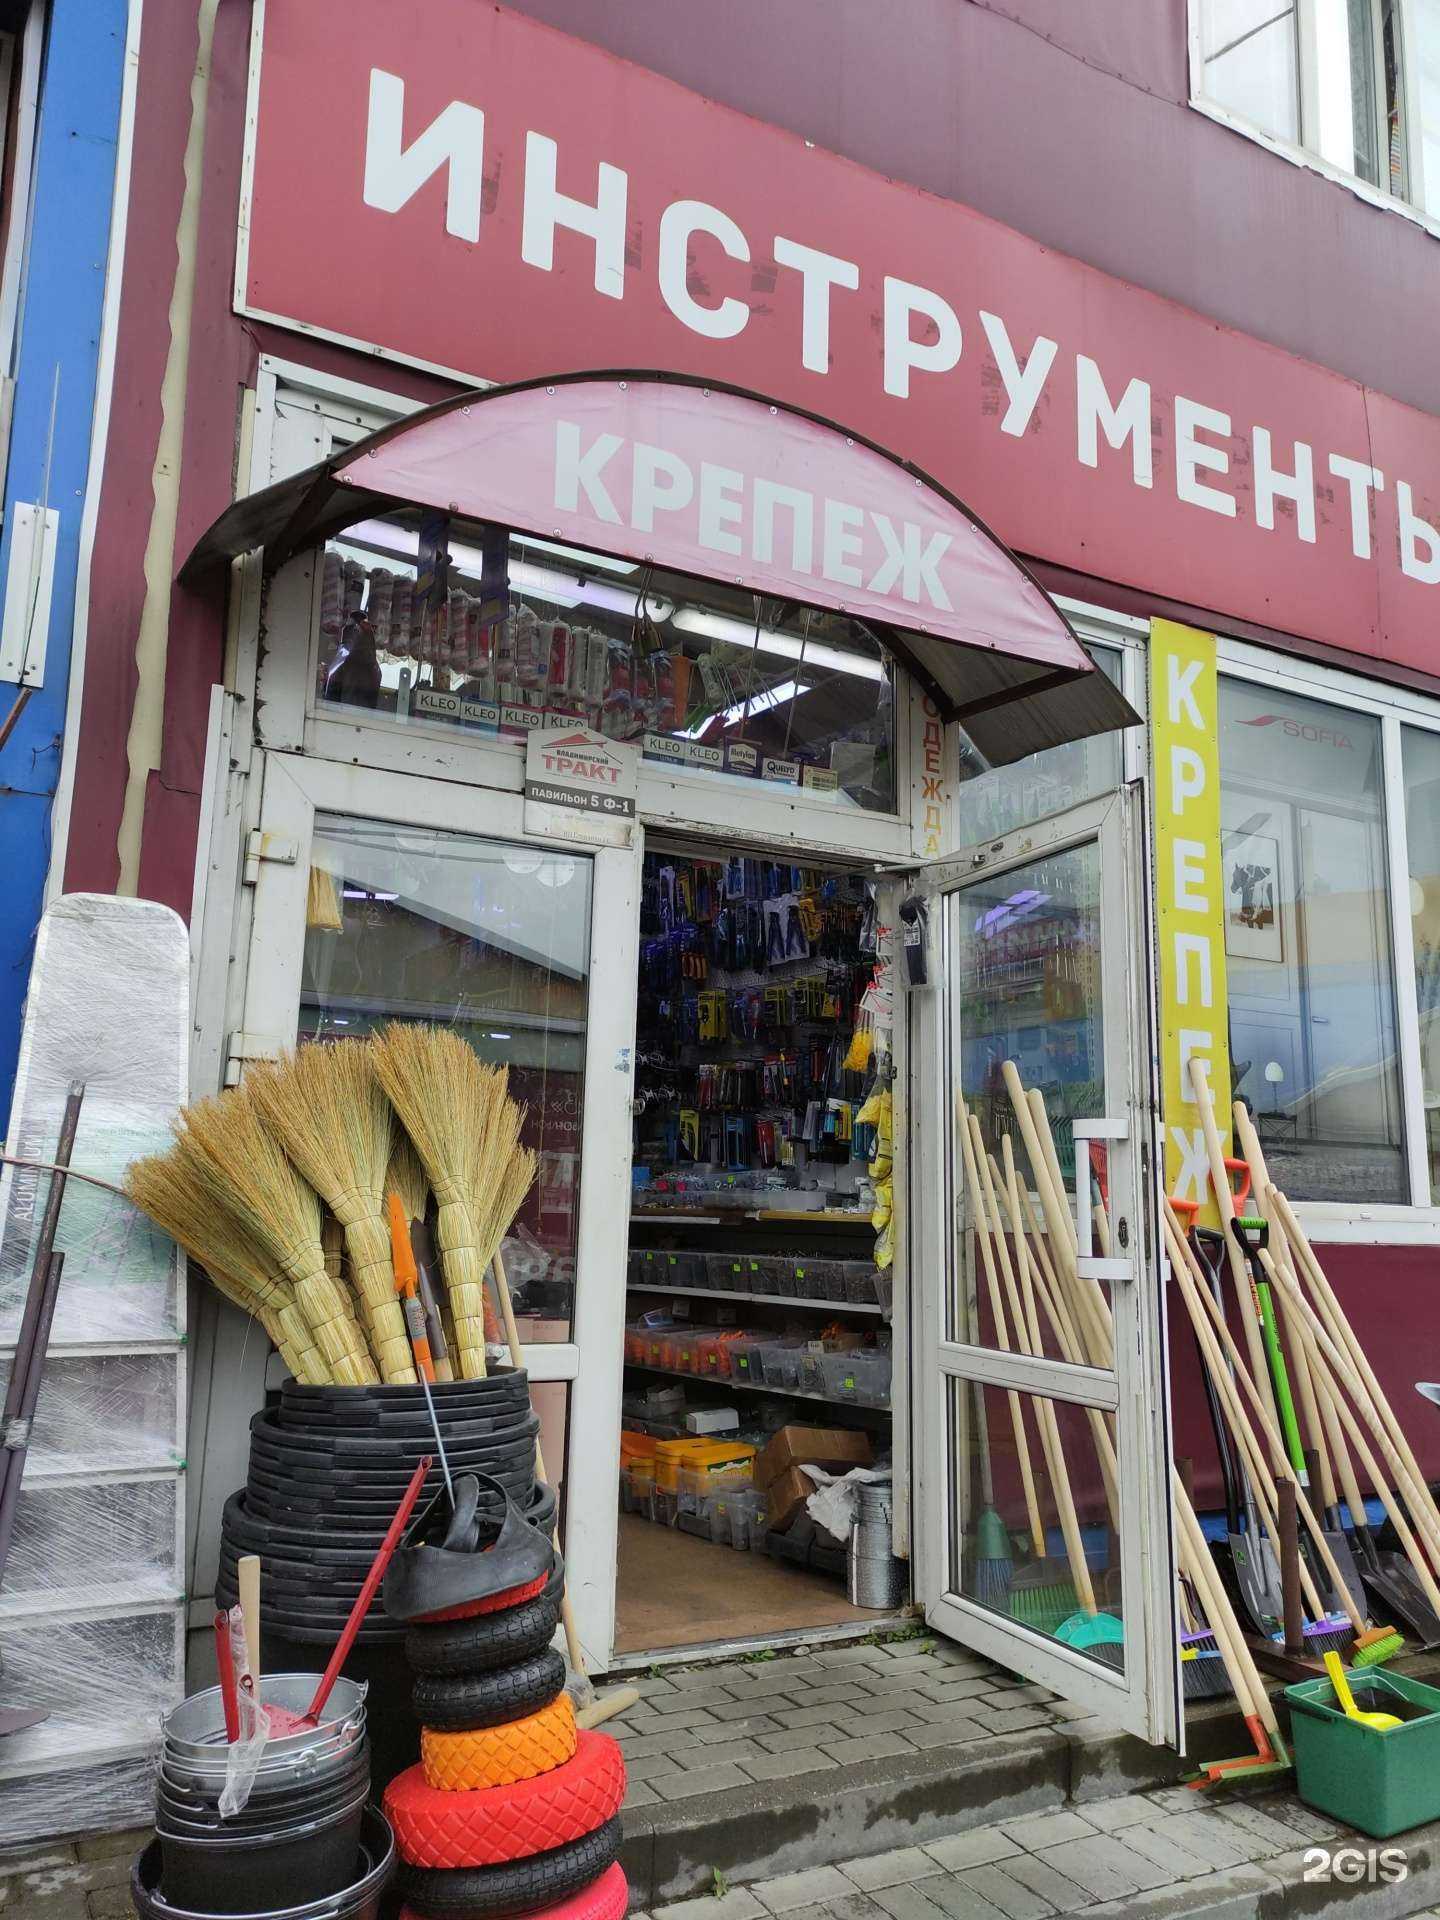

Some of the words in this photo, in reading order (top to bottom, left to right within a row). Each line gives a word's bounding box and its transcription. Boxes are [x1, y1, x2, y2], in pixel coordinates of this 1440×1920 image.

[553, 420, 956, 613] КРЕПЕЖ
[420, 695, 457, 711] KLEO
[464, 705, 496, 721] KLEO
[505, 710, 539, 726] KLEO
[649, 737, 680, 753] KLEO
[556, 749, 609, 765] ВЛАДИМИРСКИЙ
[689, 746, 720, 762] KLEO
[541, 753, 622, 784] ТРАКТ
[531, 786, 588, 806] ПАВИЛЬОН
[590, 794, 600, 807] 5
[603, 797, 630, 813] Ф-1
[1166, 653, 1229, 1205] КРЕПЕЖ
